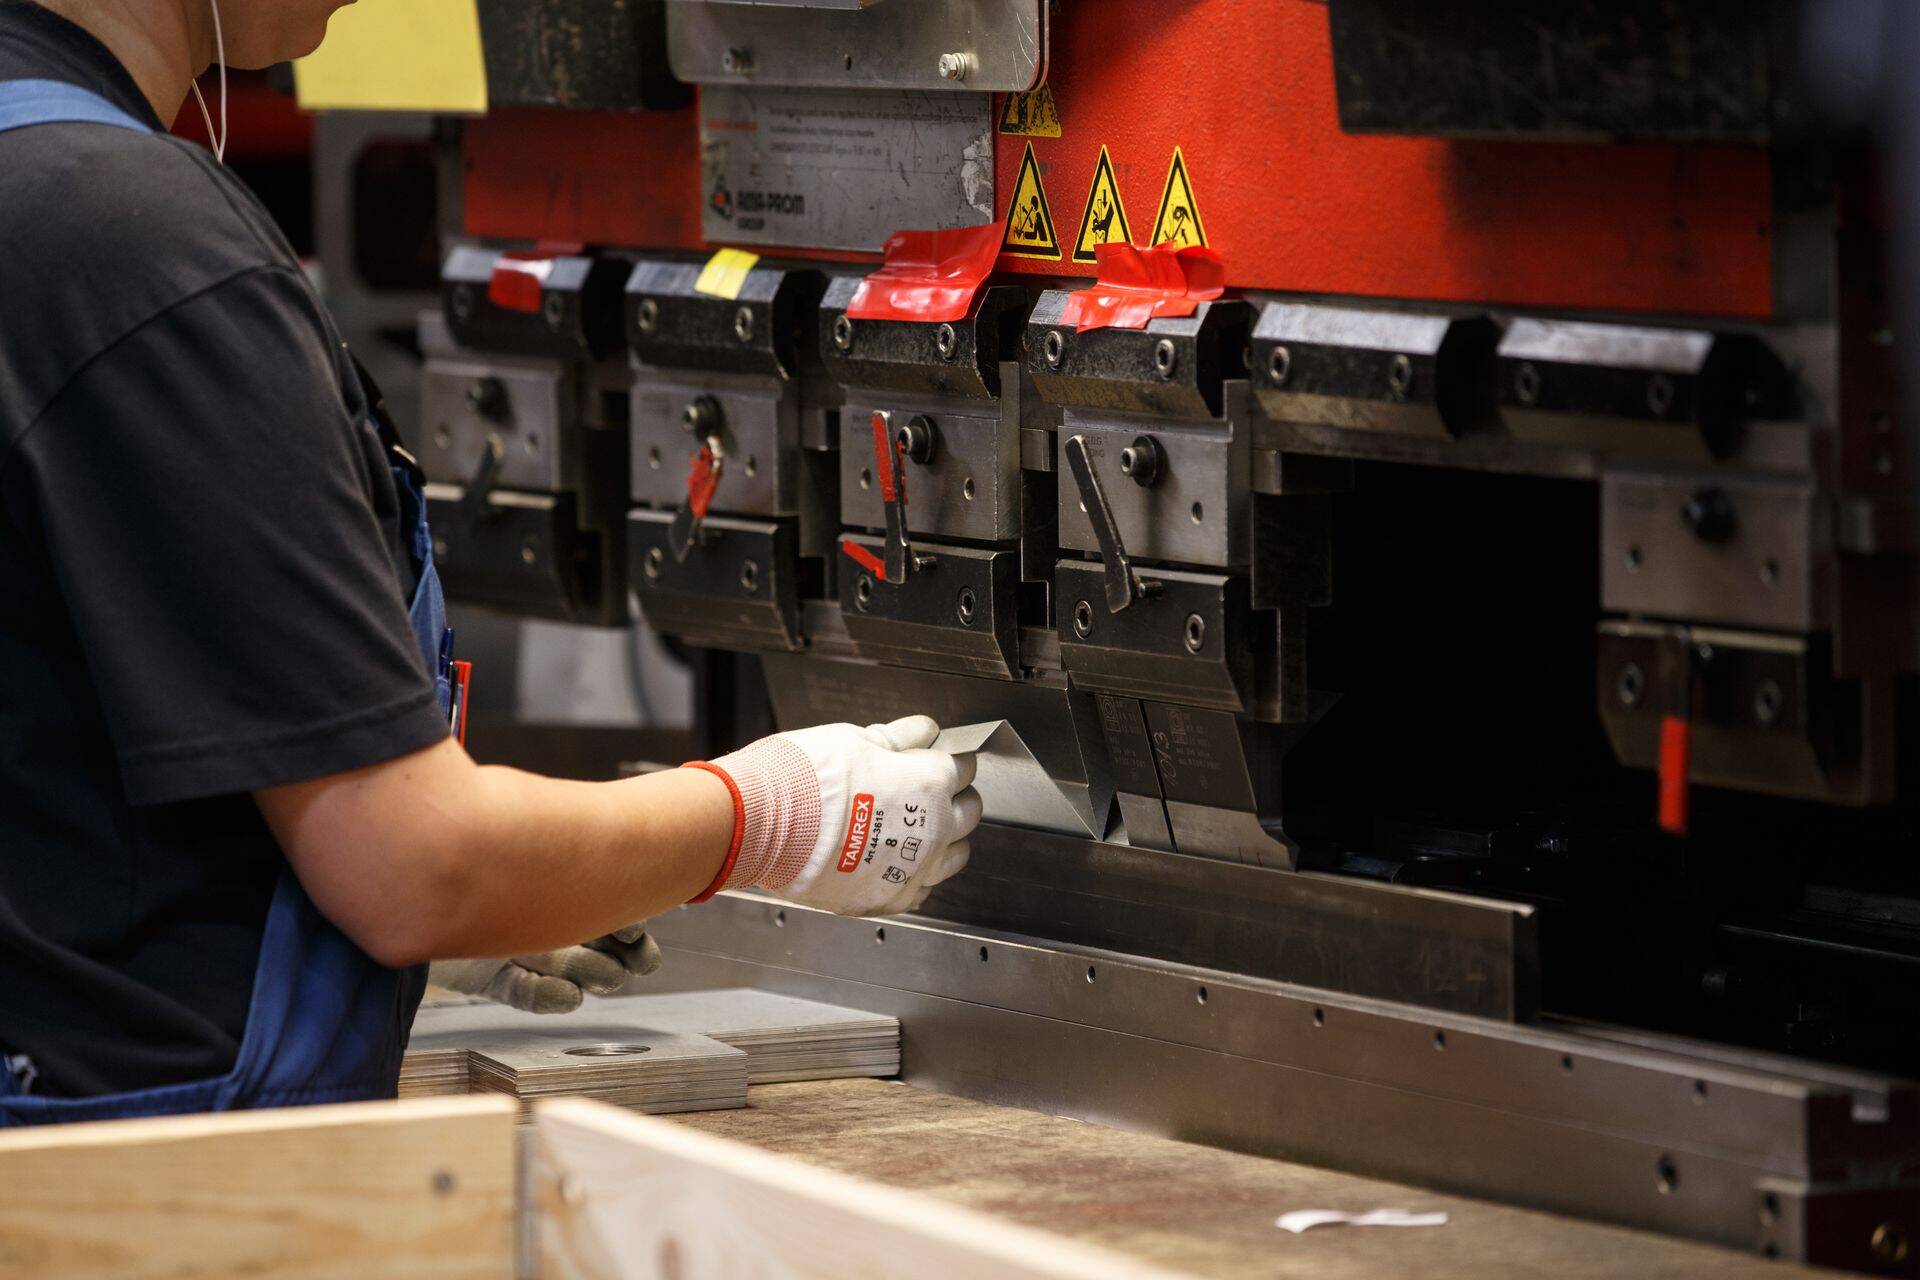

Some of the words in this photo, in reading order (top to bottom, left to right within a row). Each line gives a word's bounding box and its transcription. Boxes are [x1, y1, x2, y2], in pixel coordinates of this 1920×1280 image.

[841, 799, 870, 868] TAMREX
[864, 850, 876, 865] Art
[870, 810, 885, 849] 44-3615
[885, 838, 898, 848] 8
